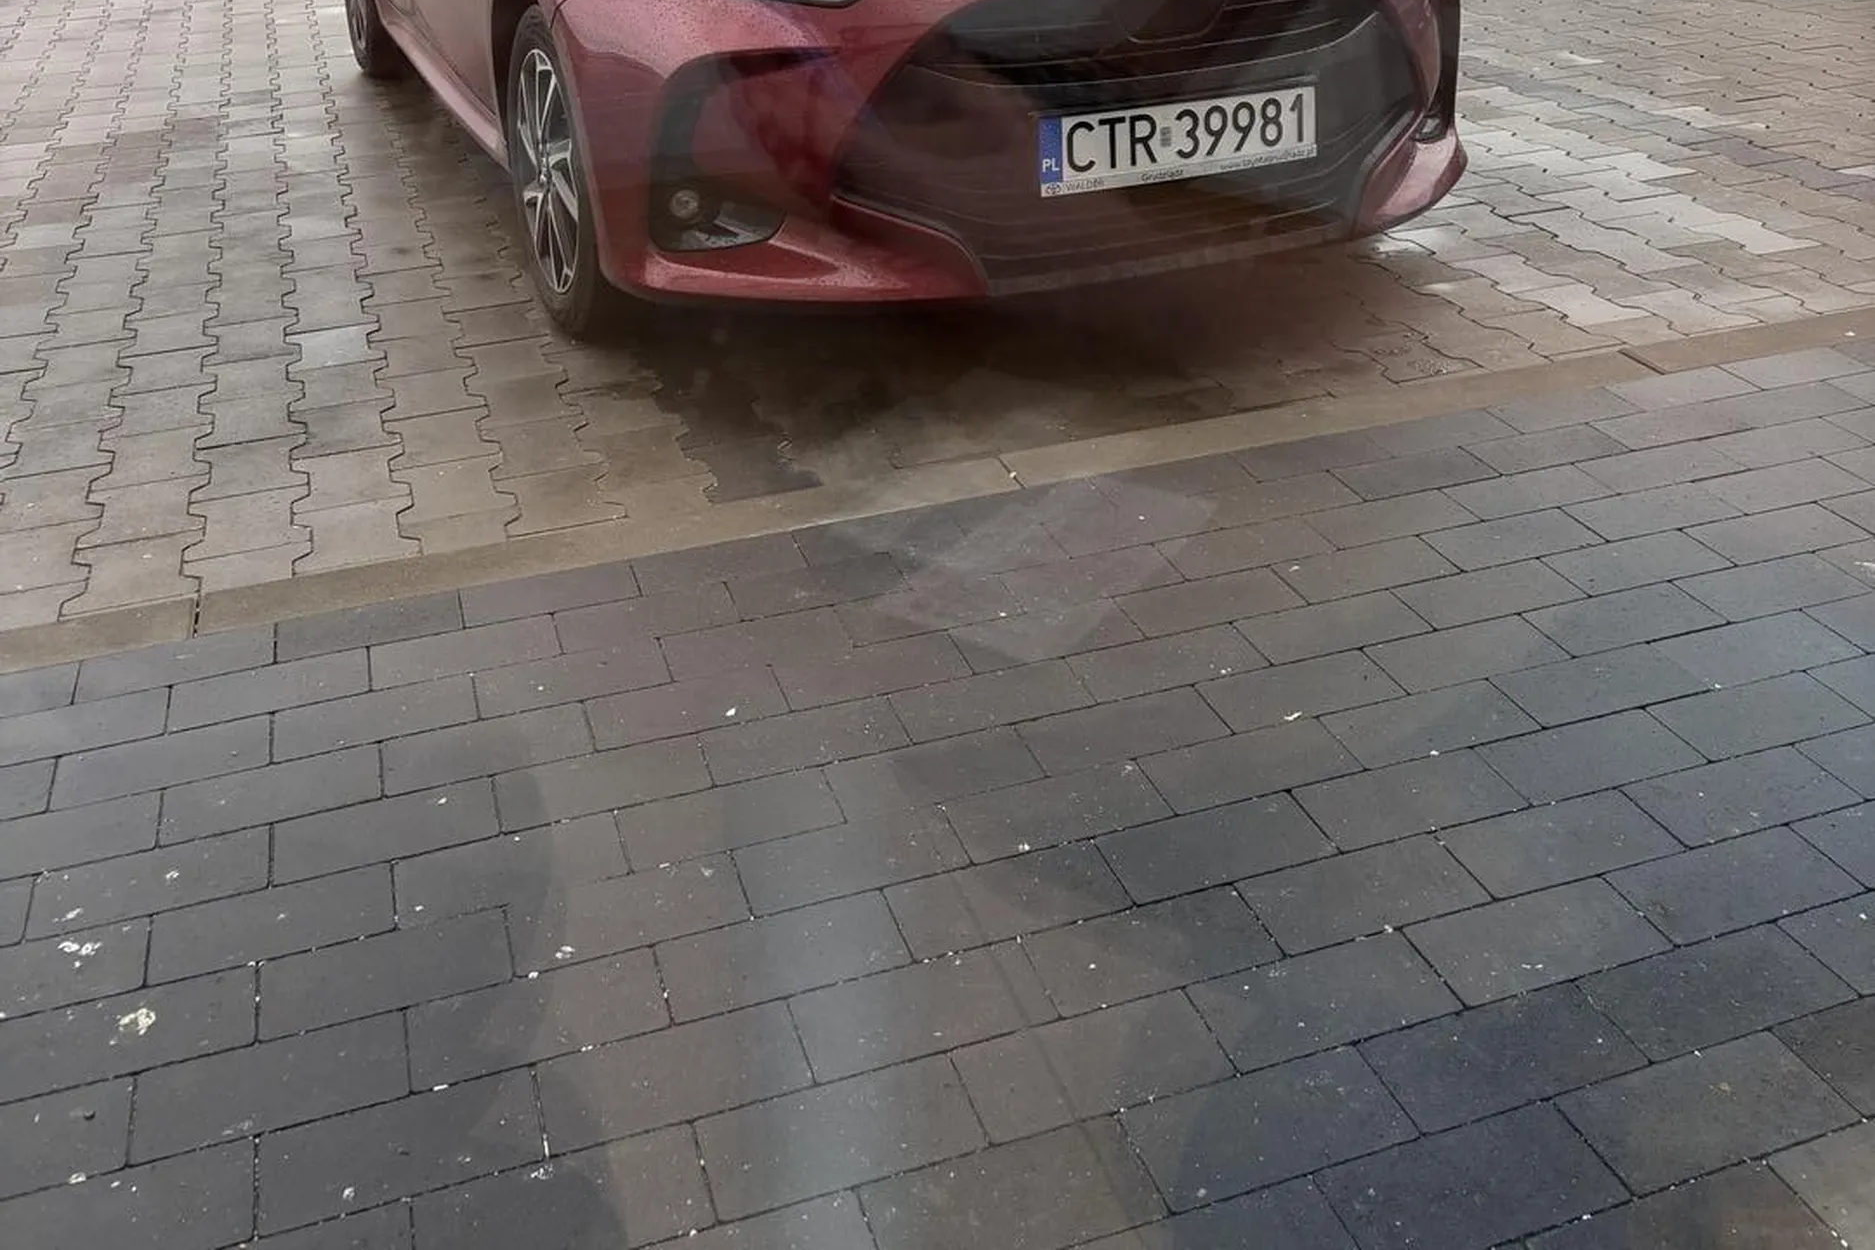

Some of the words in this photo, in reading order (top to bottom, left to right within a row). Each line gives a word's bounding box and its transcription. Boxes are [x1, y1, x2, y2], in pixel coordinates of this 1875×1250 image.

[1066, 113, 1157, 173] CTR
[1175, 93, 1304, 159] 39981
[1042, 158, 1060, 173] PL
